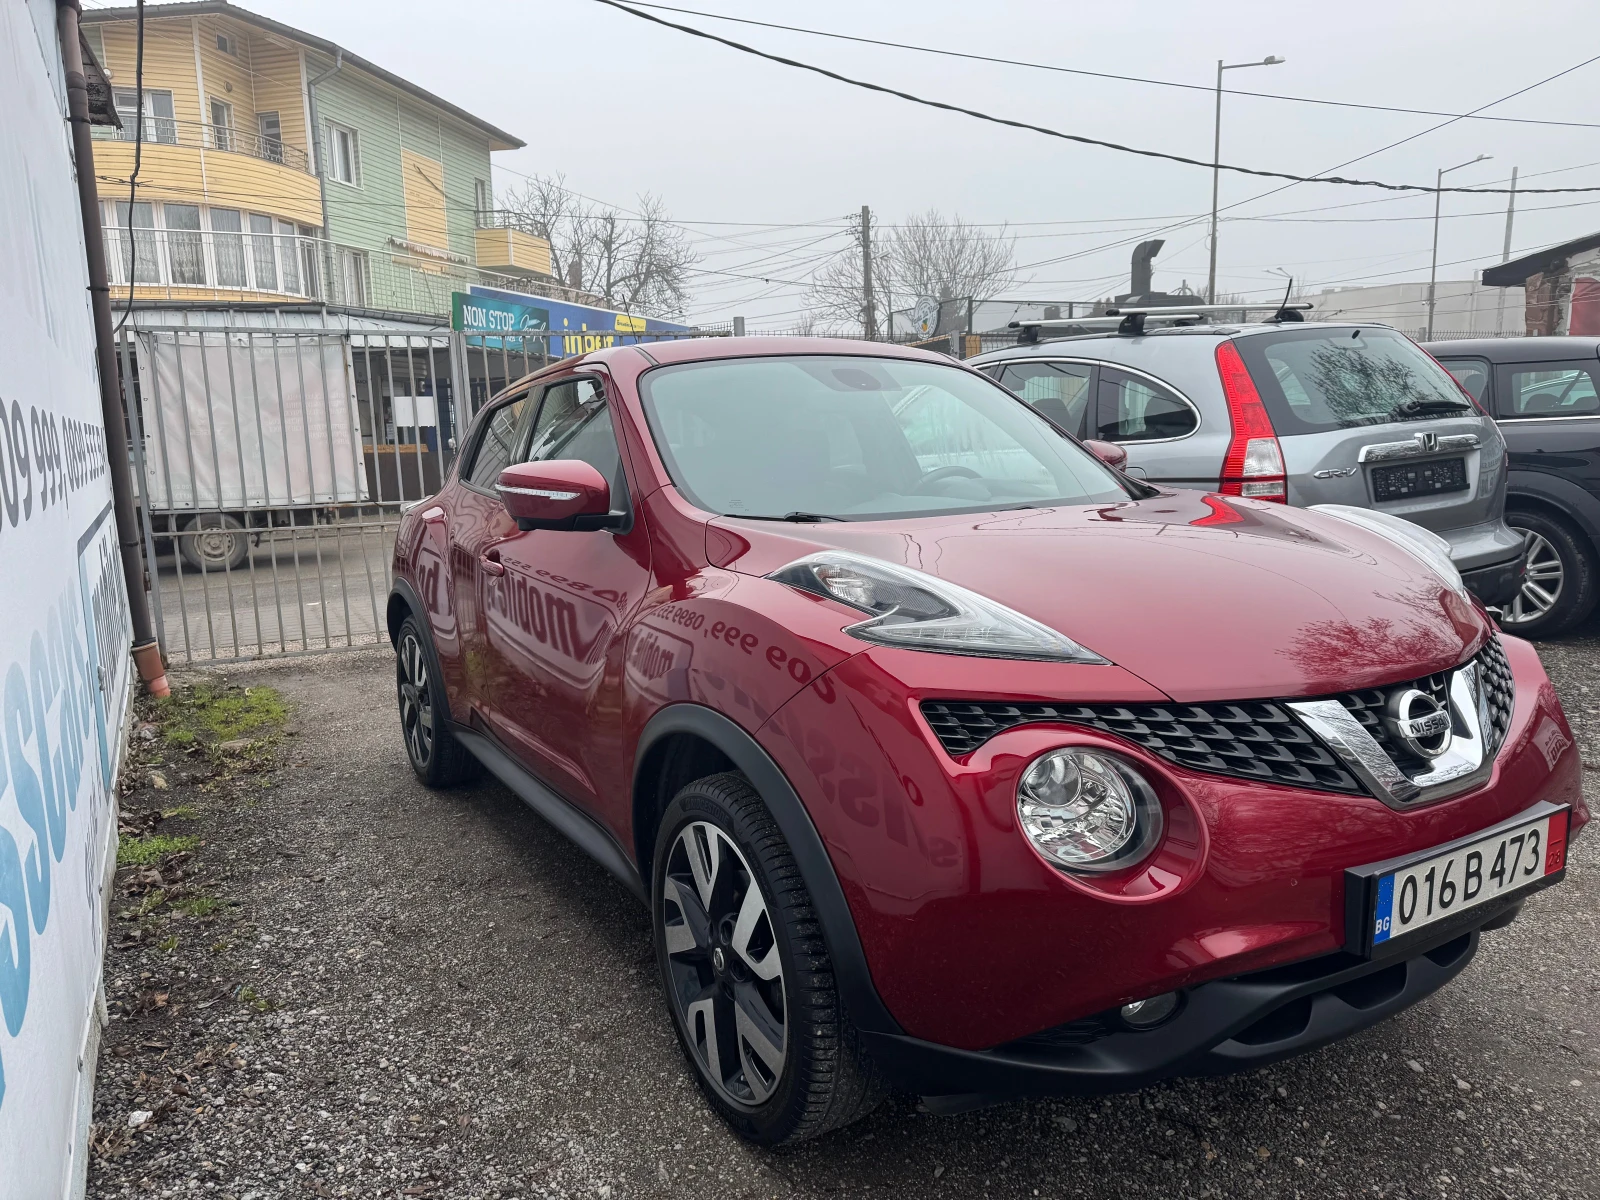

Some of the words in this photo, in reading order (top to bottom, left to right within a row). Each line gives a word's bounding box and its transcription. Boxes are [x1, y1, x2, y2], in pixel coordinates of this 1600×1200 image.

[462, 304, 487, 328] NON
[488, 309, 515, 331] STOP
[0, 397, 33, 530] 09
[1313, 467, 1357, 480] CR-V
[1374, 916, 1390, 935] BG
